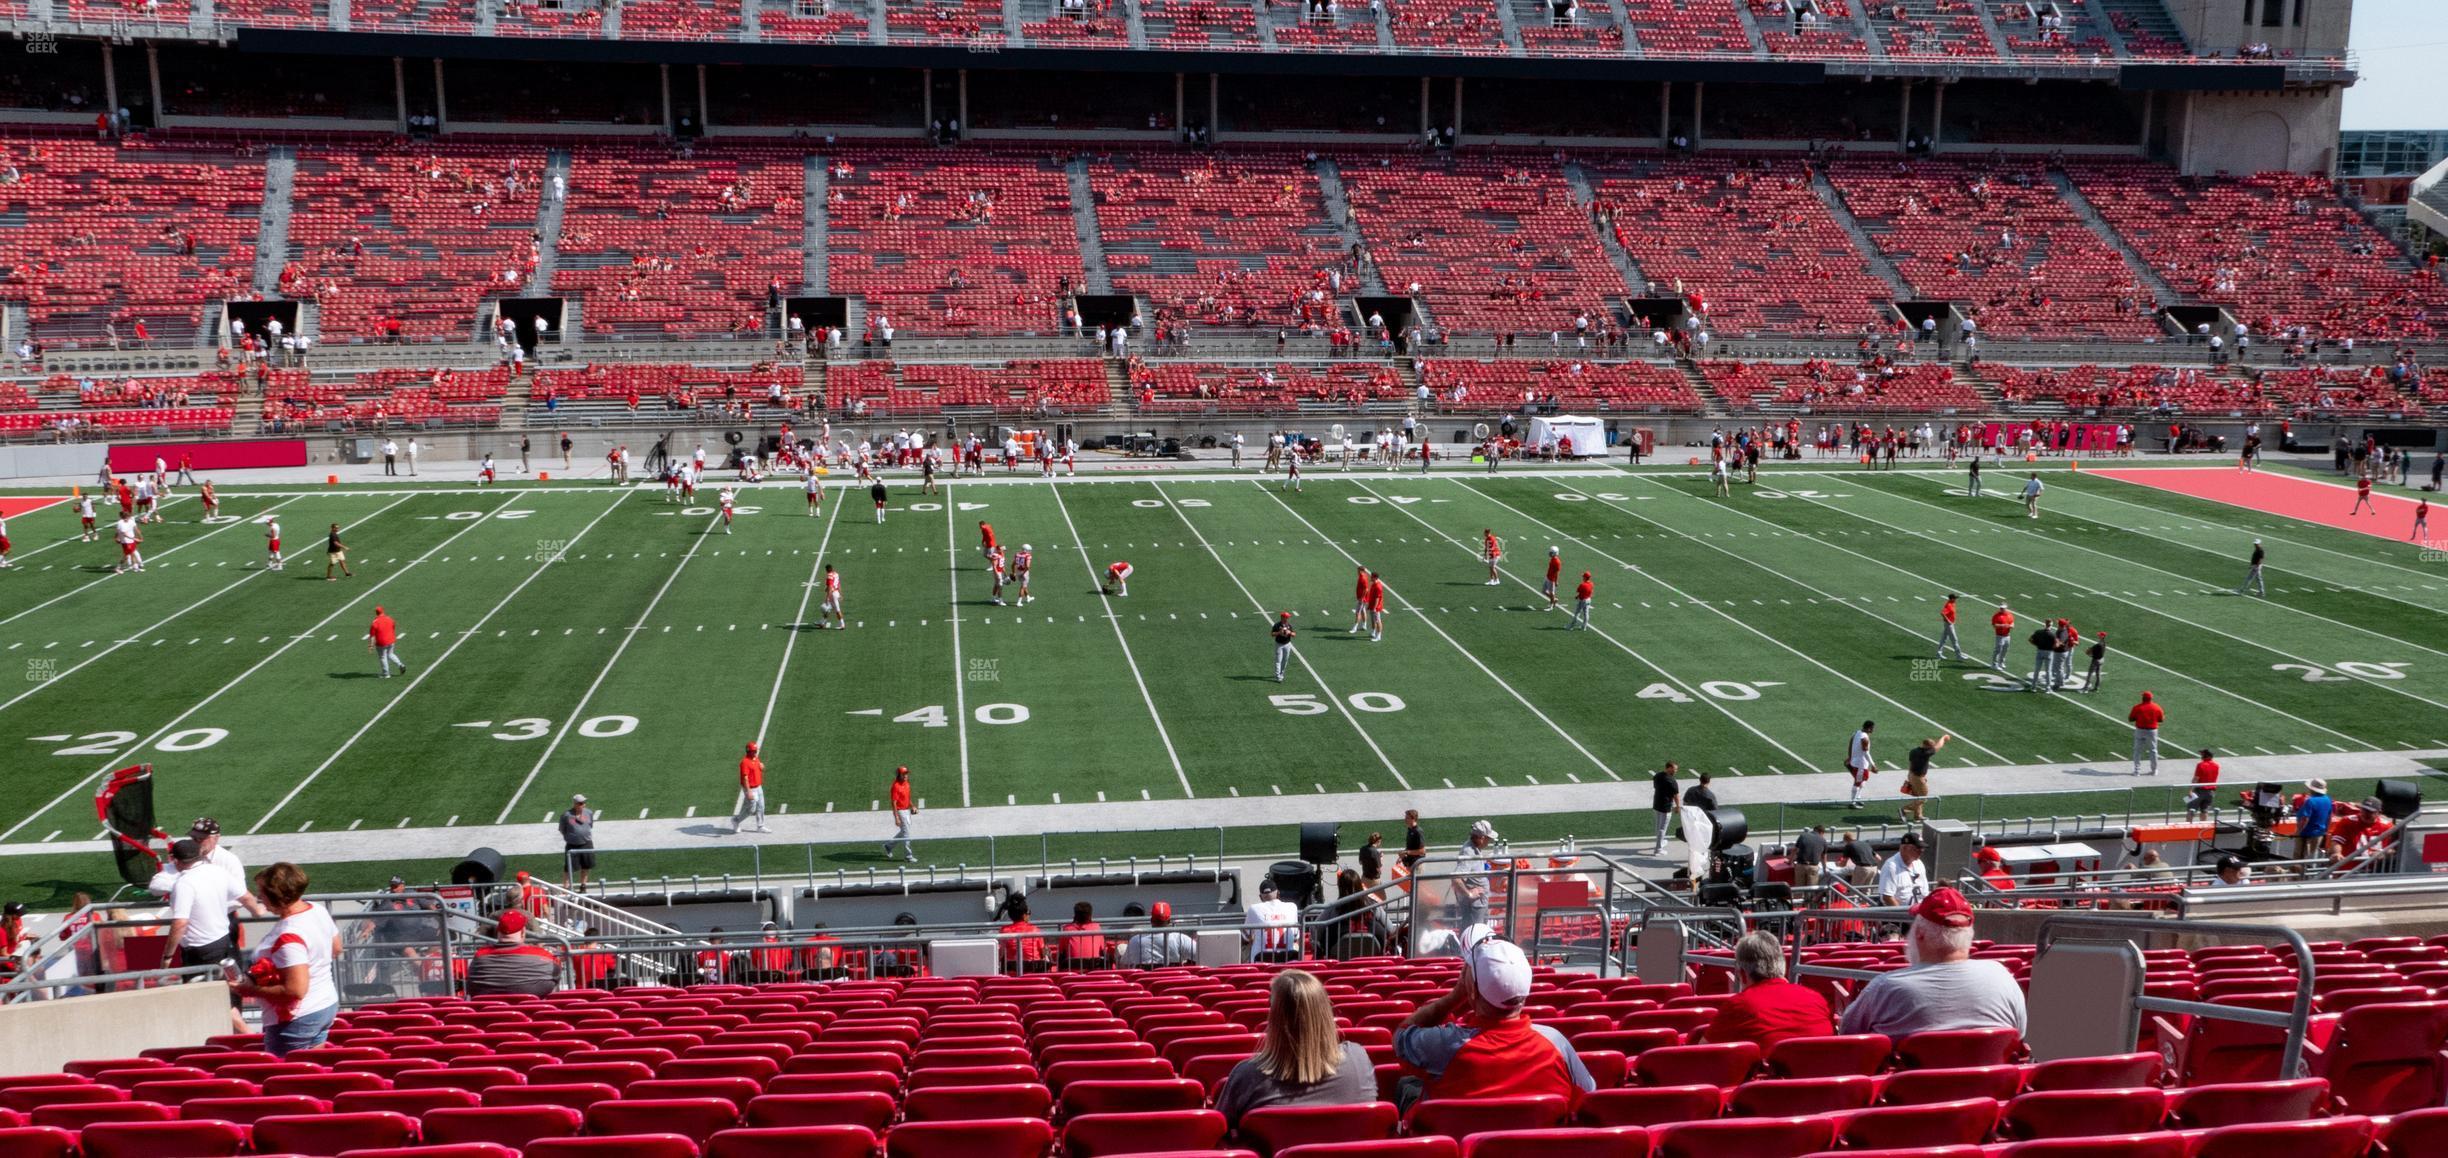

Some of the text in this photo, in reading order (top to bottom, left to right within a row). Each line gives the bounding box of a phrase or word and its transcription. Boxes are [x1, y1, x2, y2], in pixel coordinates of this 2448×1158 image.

[2271, 661, 2407, 682] 20
[1635, 680, 1762, 703] 40
[893, 703, 1031, 727] 40
[1267, 692, 1407, 715] 50
[491, 715, 640, 741] 30
[51, 727, 230, 756] 20
